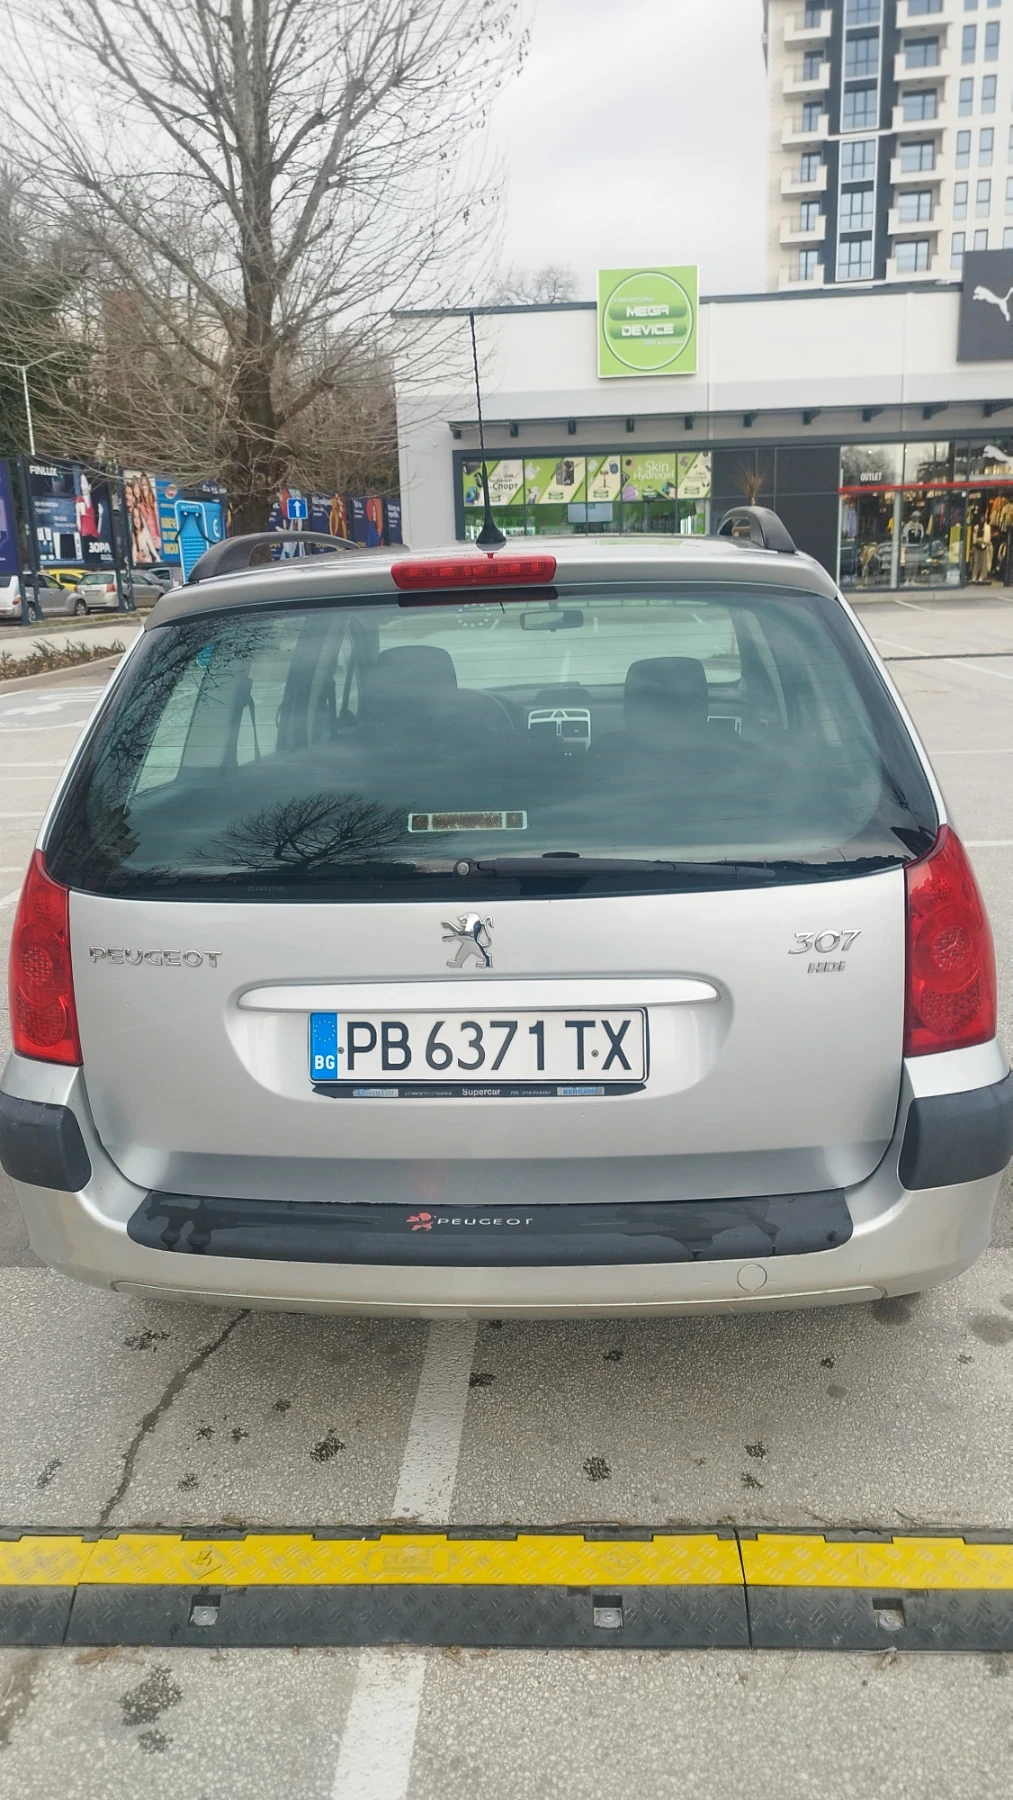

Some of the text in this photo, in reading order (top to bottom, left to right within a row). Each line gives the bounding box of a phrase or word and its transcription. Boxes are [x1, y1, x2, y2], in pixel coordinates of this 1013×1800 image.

[626, 305, 669, 317] MEGA
[621, 323, 674, 336] DEVICE
[29, 465, 58, 477] FINLUX
[644, 460, 669, 472] Skin
[633, 470, 674, 481] Hydrogel
[861, 472, 881, 481] OUTLET
[492, 482, 519, 491] Спорт
[787, 929, 862, 955] 307
[89, 946, 222, 968] PEUGEOT
[346, 1019, 633, 1071] PB 6371 TX
[314, 1055, 336, 1070] BG
[462, 1087, 501, 1097] Supercar
